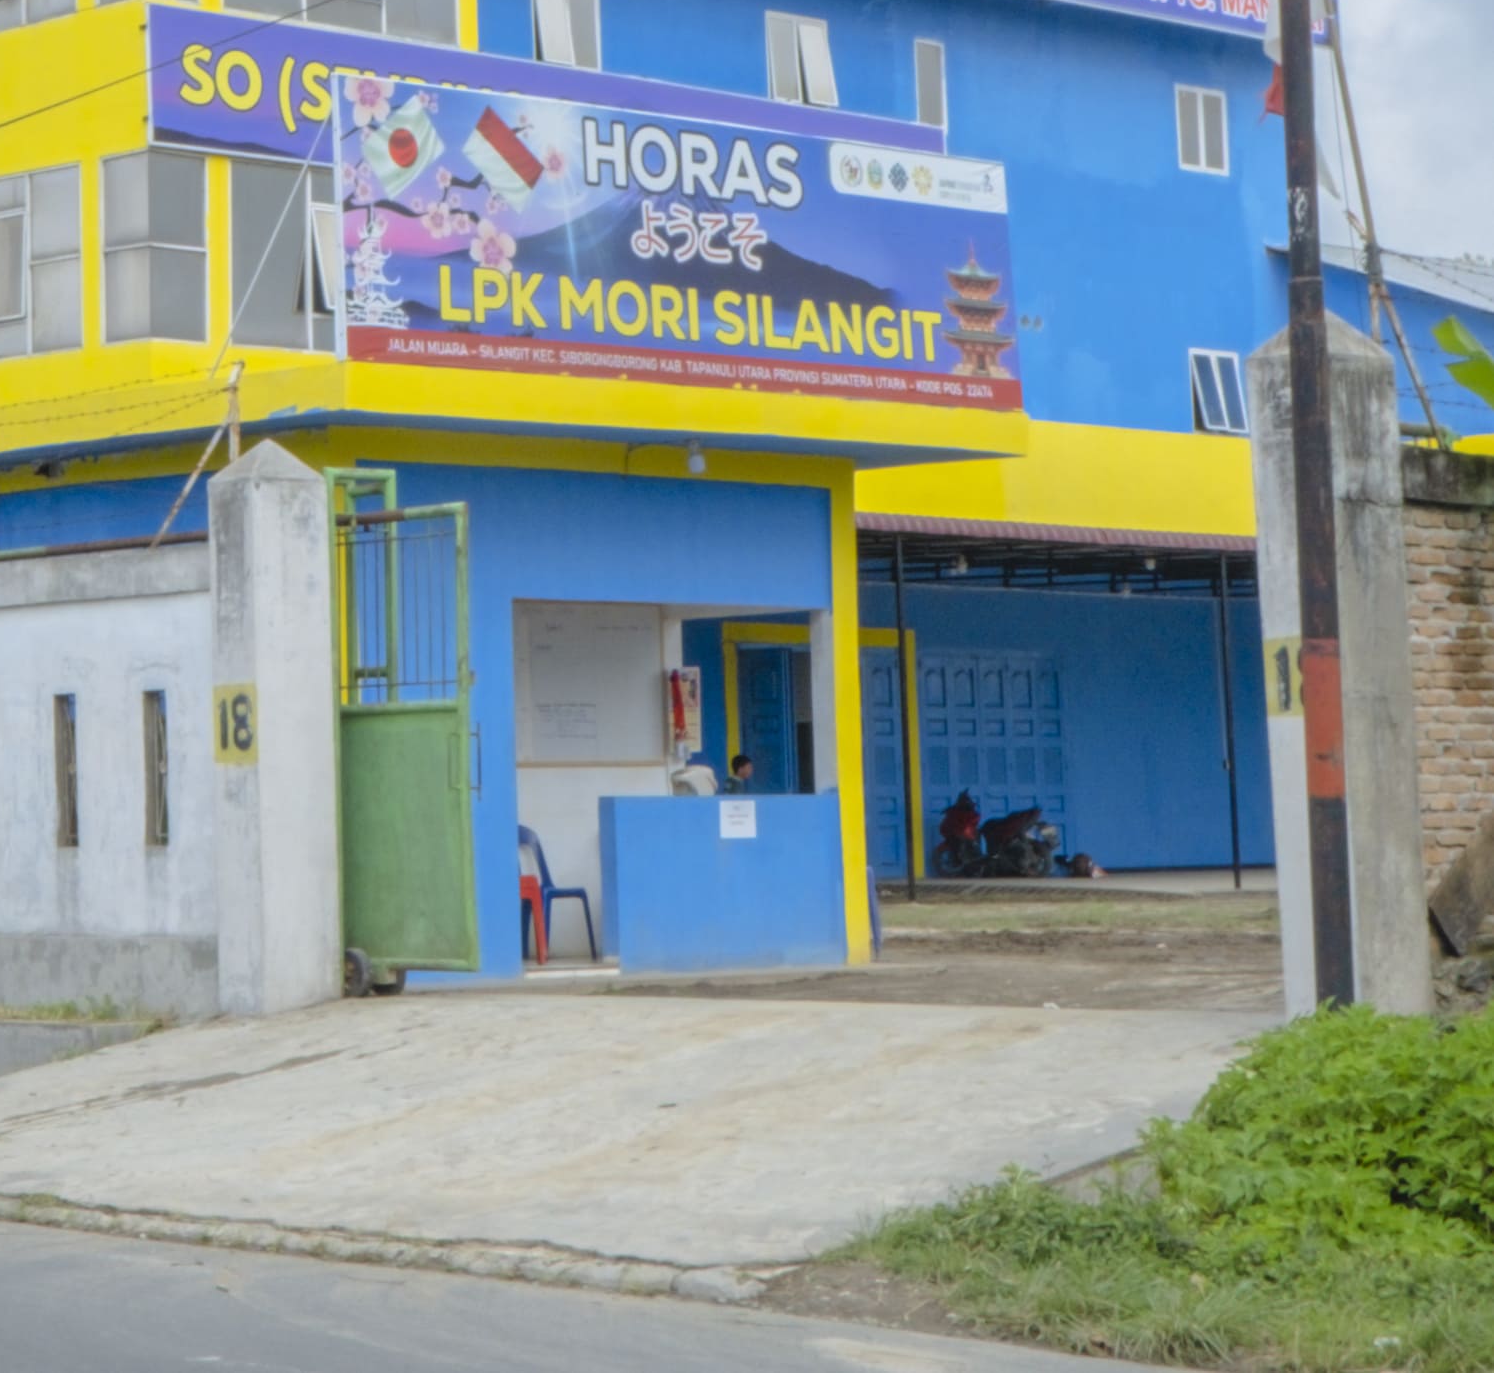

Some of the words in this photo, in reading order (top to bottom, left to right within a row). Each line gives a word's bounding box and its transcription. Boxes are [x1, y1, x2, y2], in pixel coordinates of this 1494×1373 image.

[179, 43, 263, 112] SO
[582, 116, 804, 211] HORAS
[631, 199, 768, 271] ようこそ
[438, 264, 548, 329] LPK
[559, 275, 700, 343] MORI
[714, 289, 943, 363] SILANGIT
[388, 338, 424, 354] JALAN
[427, 340, 468, 357] MUARA
[479, 344, 530, 362] SILANGIT
[686, 360, 737, 378] TAPANULI
[738, 365, 772, 380] UTARA
[822, 371, 874, 388] SUMATERA
[219, 692, 253, 752] 18
